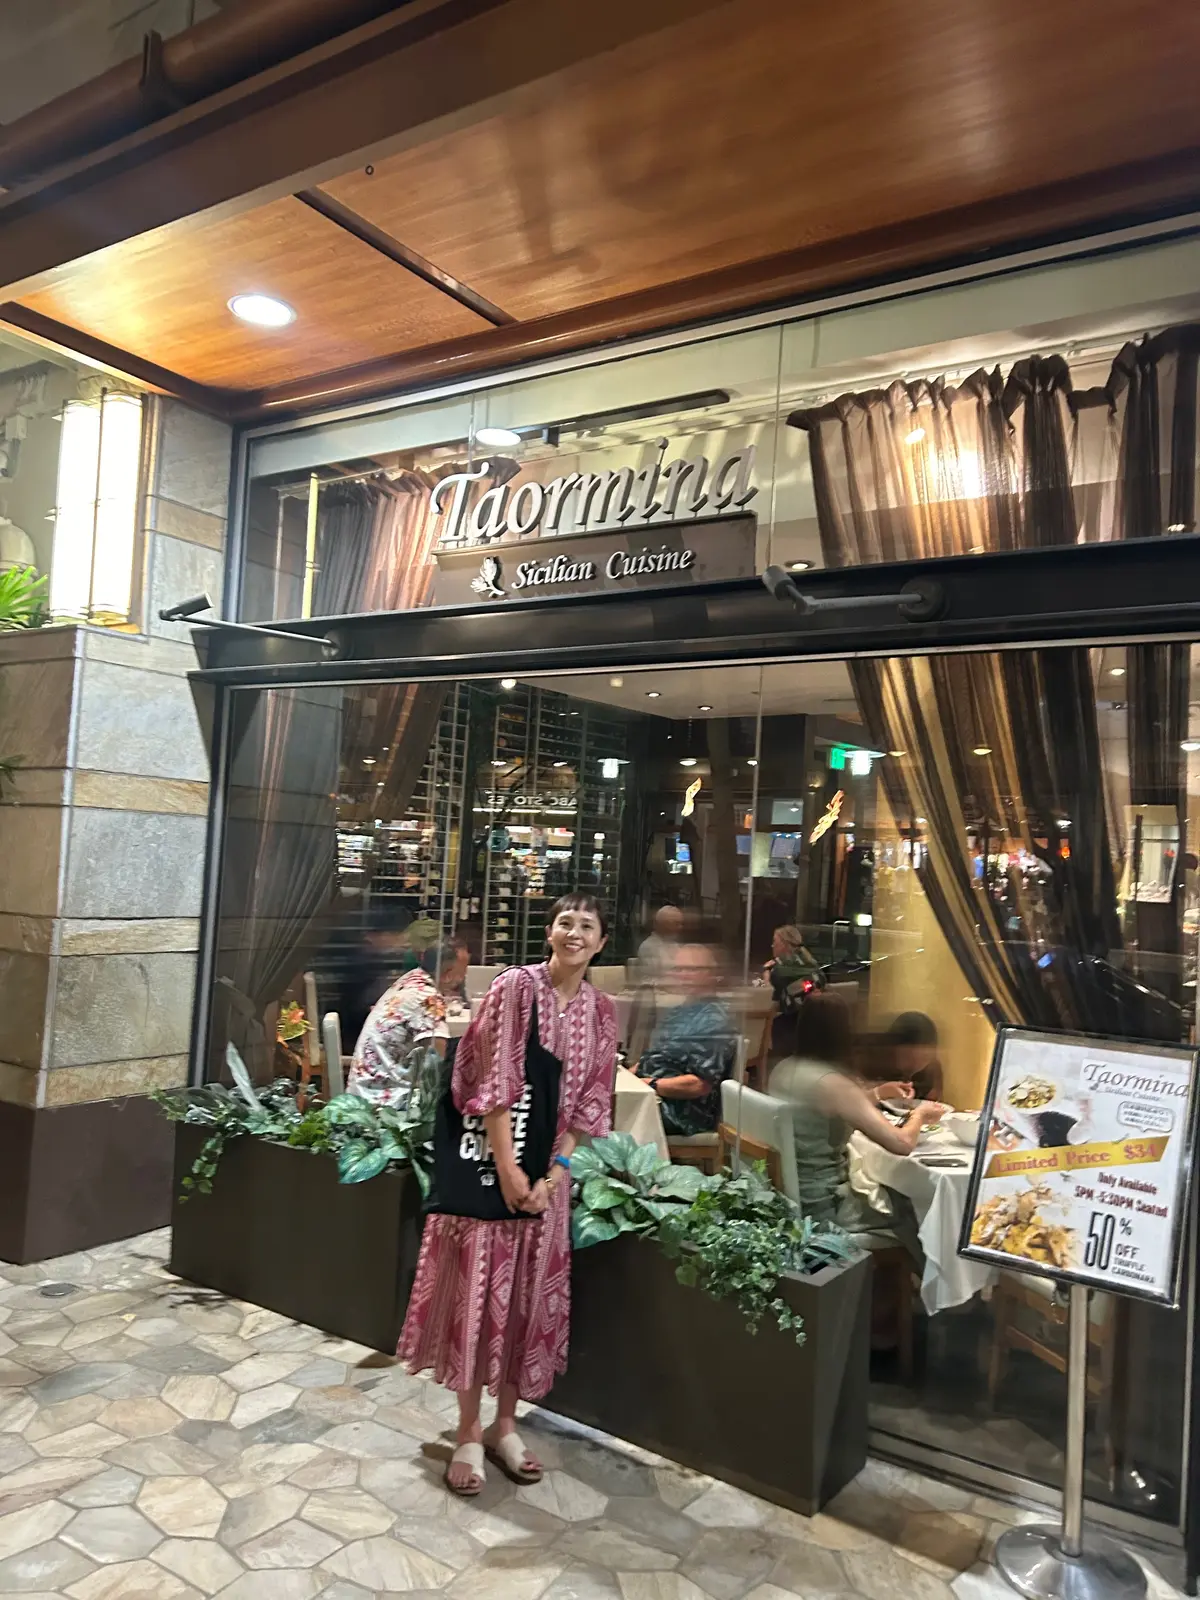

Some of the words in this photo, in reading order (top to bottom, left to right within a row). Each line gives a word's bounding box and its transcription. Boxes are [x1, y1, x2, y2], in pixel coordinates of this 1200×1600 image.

[430, 436, 760, 543] Taormina
[511, 554, 595, 590] Sicilian
[606, 544, 696, 580] Cuisine
[1083, 1063, 1190, 1098] Taormina
[995, 1153, 1058, 1172] Limited
[1066, 1149, 1111, 1165] Price
[1098, 1171, 1117, 1187] Only
[1118, 1176, 1158, 1195] Available
[1135, 1199, 1169, 1218] Seated
[1115, 1243, 1140, 1259] OFF
